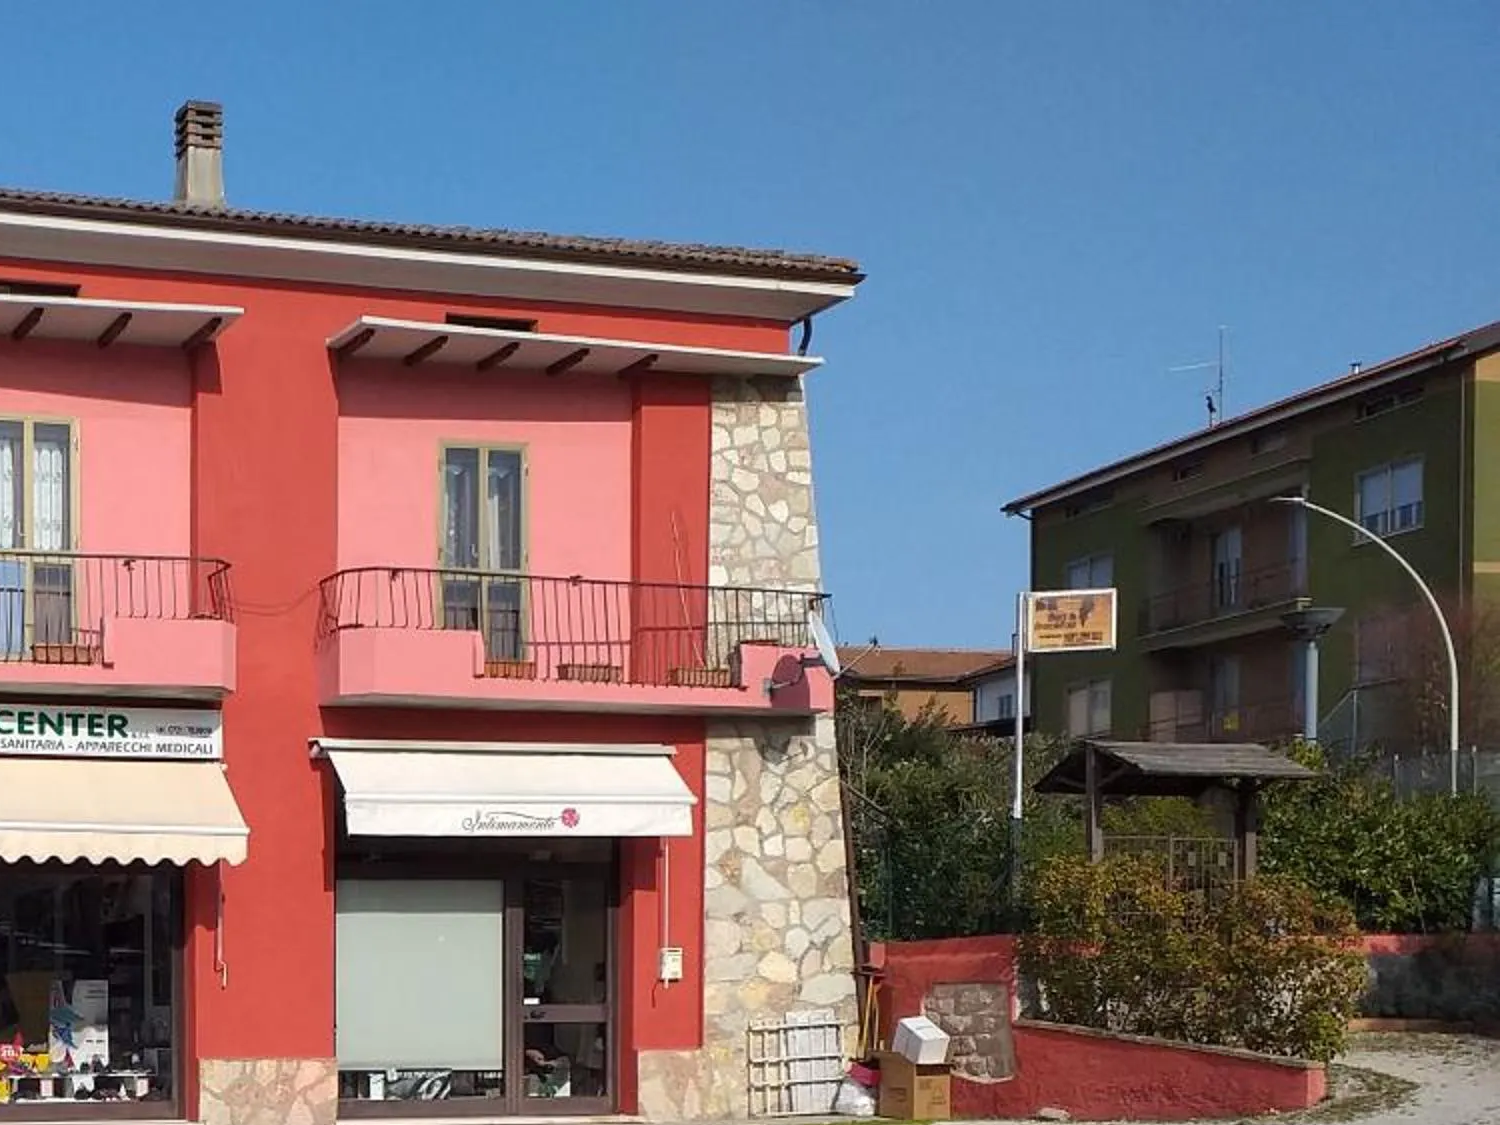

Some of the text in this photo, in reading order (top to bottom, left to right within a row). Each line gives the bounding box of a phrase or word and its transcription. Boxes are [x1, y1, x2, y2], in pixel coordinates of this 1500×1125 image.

[0, 737, 65, 751] SANITARIA
[75, 740, 151, 753] APPARECCHI
[155, 742, 213, 755] MEDICALI
